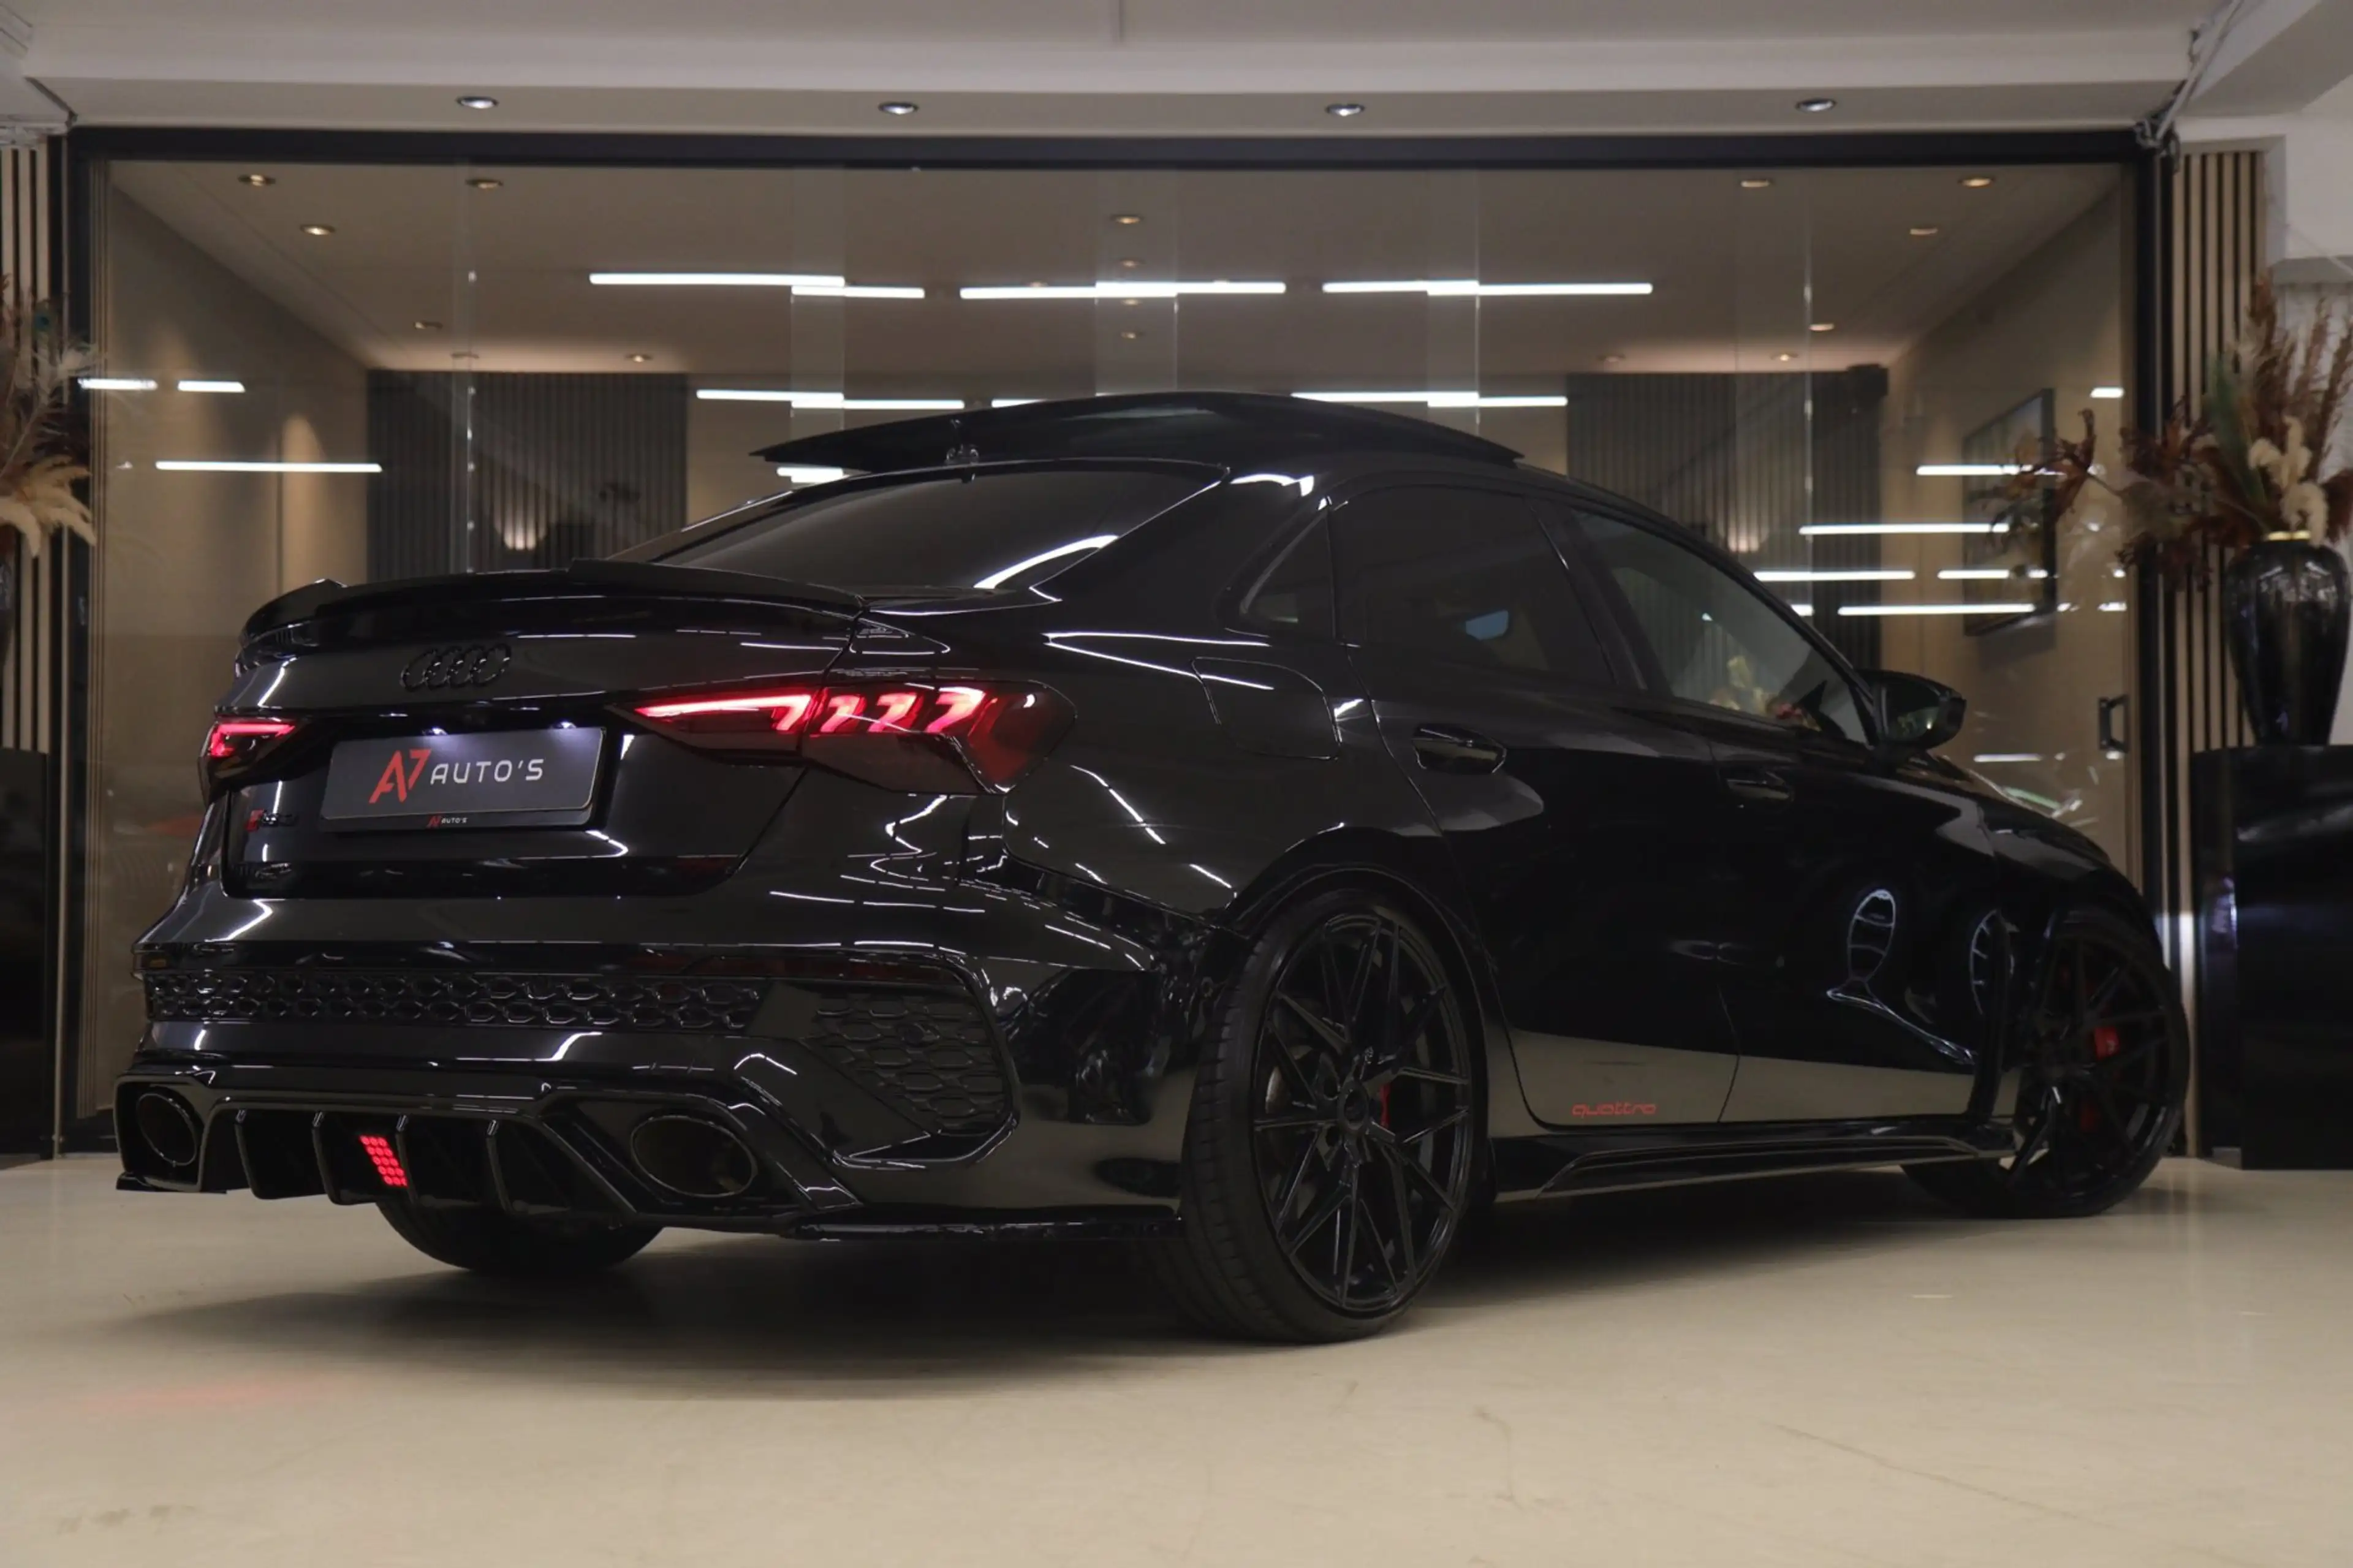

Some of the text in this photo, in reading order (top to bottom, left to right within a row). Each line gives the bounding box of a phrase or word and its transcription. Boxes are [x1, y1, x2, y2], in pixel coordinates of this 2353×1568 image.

[368, 749, 544, 804] A7 AUTO'S
[1572, 1102, 1656, 1119] quattro
